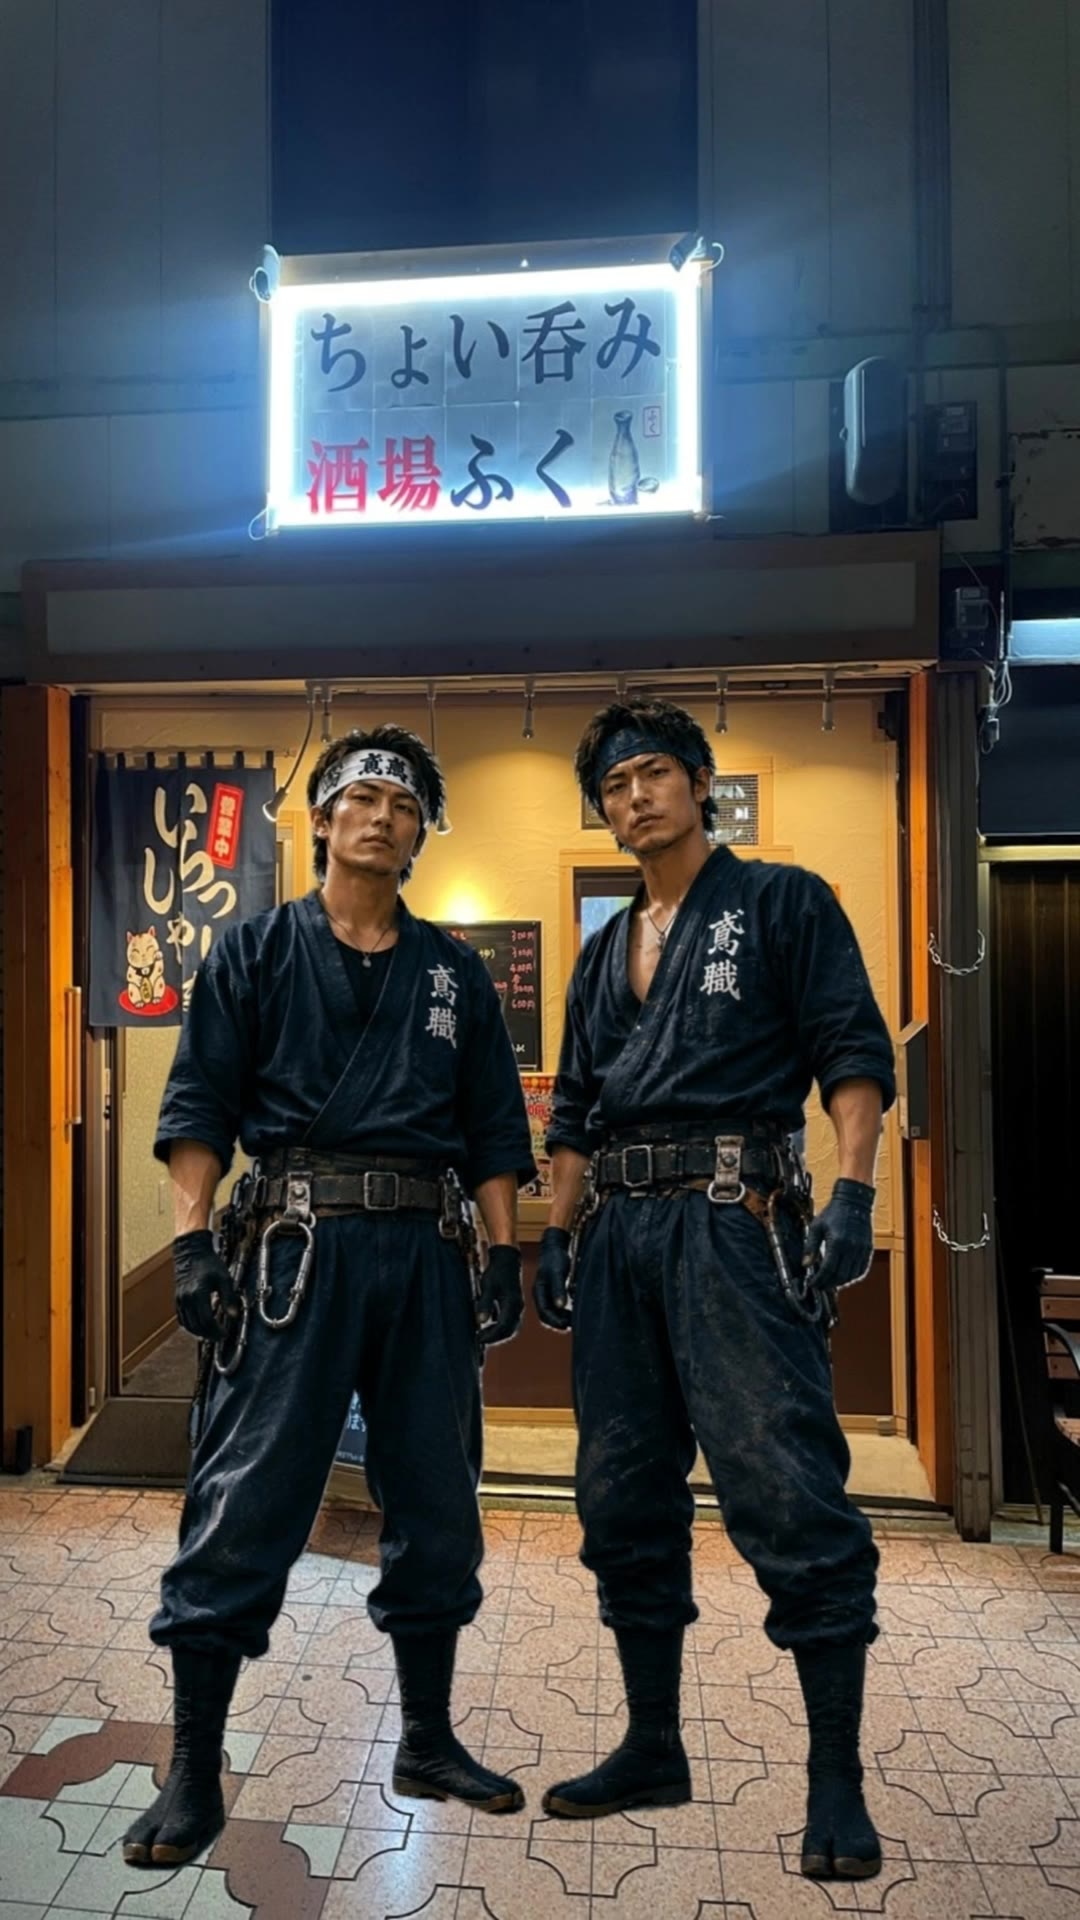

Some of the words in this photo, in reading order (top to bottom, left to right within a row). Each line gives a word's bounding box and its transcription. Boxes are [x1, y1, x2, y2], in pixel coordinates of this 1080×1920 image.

[309, 297, 662, 393] ちょい呑み
[307, 428, 575, 515] 酒場ふく
[214, 795, 236, 858] 営業中
[699, 908, 745, 1001] 鳶職
[424, 963, 459, 1049] 鳶職
